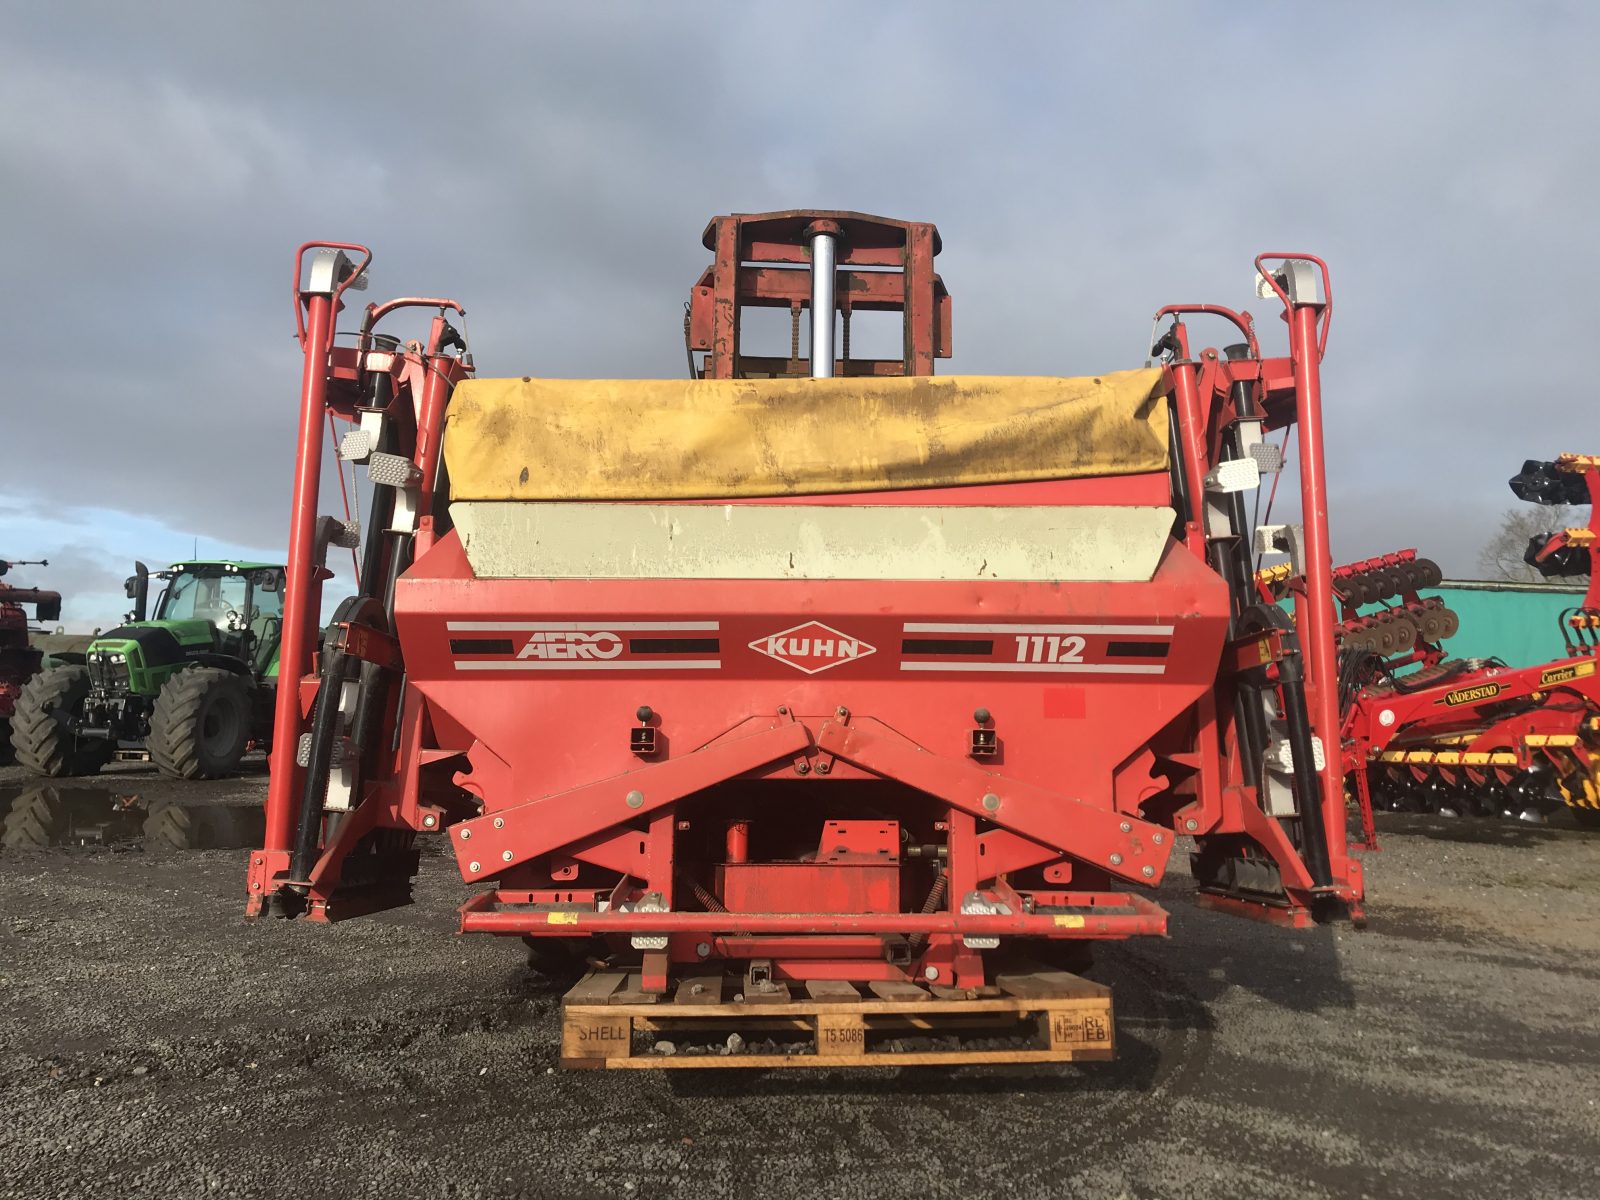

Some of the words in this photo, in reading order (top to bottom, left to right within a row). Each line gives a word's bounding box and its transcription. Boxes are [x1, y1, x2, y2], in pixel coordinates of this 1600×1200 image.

[516, 632, 623, 659] AERO
[767, 637, 858, 657] KUHN
[1015, 636, 1086, 663] 1112
[1542, 669, 1574, 684] Carrier
[579, 1026, 626, 1040] SHELL
[840, 1028, 863, 1042] 5086
